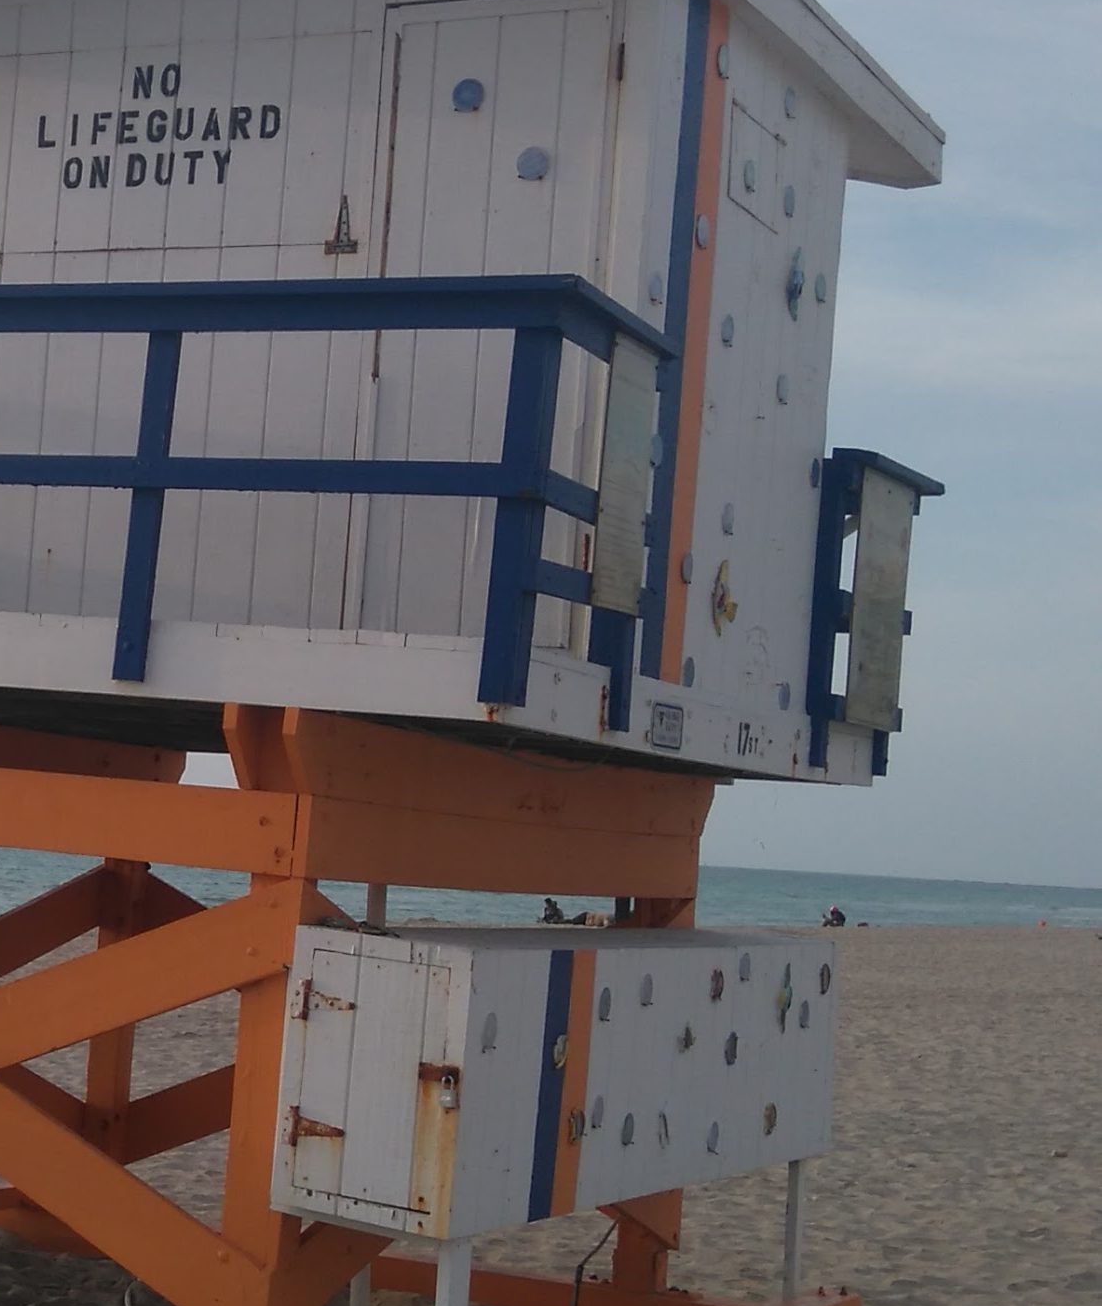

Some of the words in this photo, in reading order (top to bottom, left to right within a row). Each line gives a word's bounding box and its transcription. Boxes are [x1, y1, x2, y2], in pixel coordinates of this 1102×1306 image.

[133, 63, 181, 99] NO
[38, 104, 281, 148] LIFEGUARD
[63, 155, 111, 189] ON
[125, 149, 231, 187] DUTY
